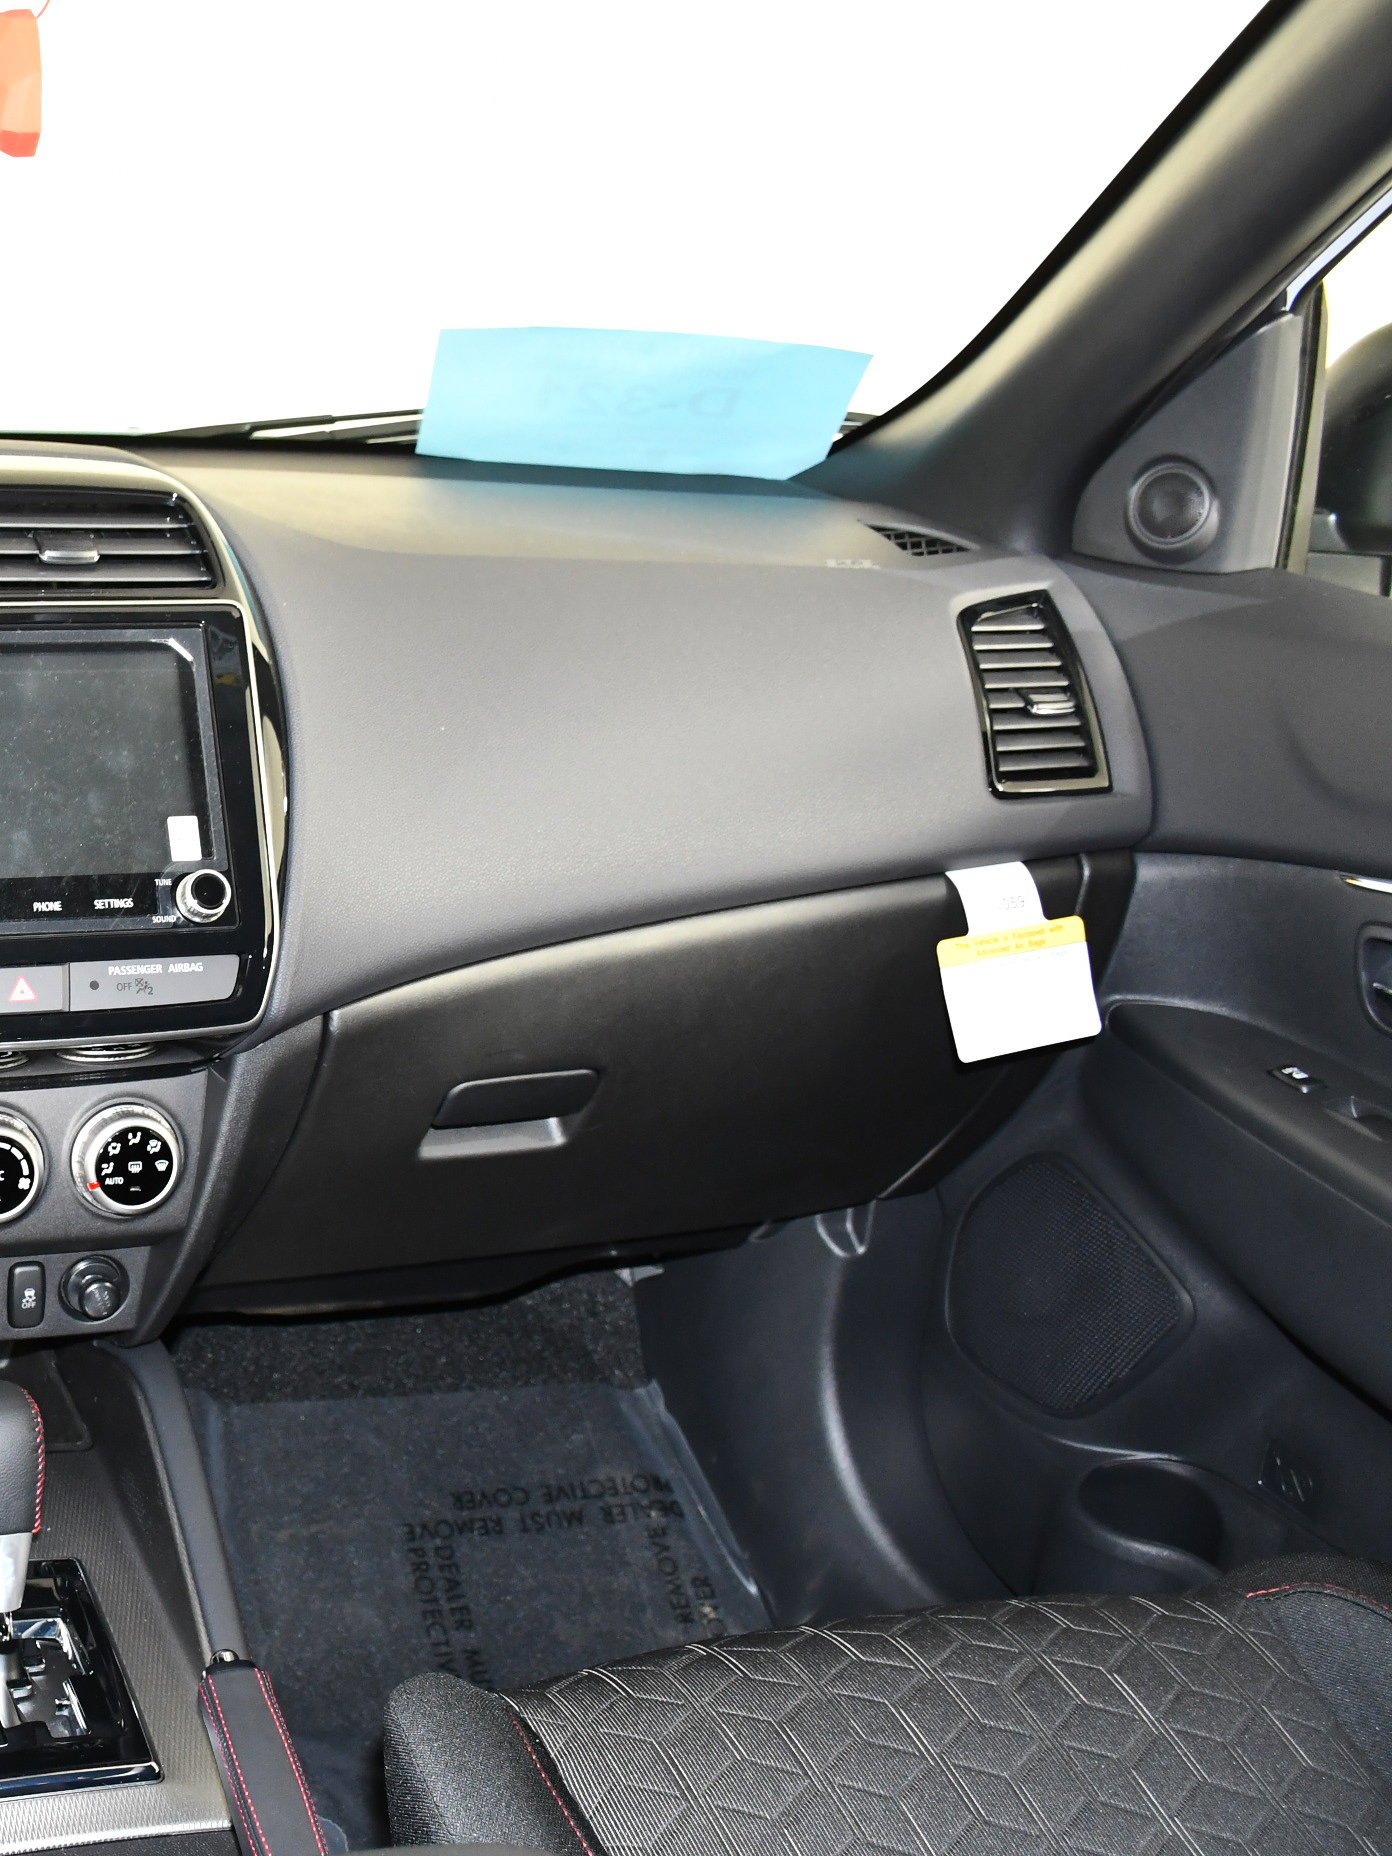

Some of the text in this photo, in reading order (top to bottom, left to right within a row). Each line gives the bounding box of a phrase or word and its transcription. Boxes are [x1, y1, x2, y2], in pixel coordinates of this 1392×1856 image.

[154, 878, 172, 887] TUNE
[33, 900, 63, 912] PHONE
[93, 898, 134, 910] SETTINGS
[151, 914, 177, 924] SOUND
[108, 962, 204, 976] PASSENGER AIRBAG
[116, 981, 132, 992] OFF
[105, 1176, 124, 1185] AUTO
[21, 1300, 37, 1309] OFF
[400, 1514, 504, 1543] REMOVE
[408, 1548, 459, 1677] PROTECTIV
